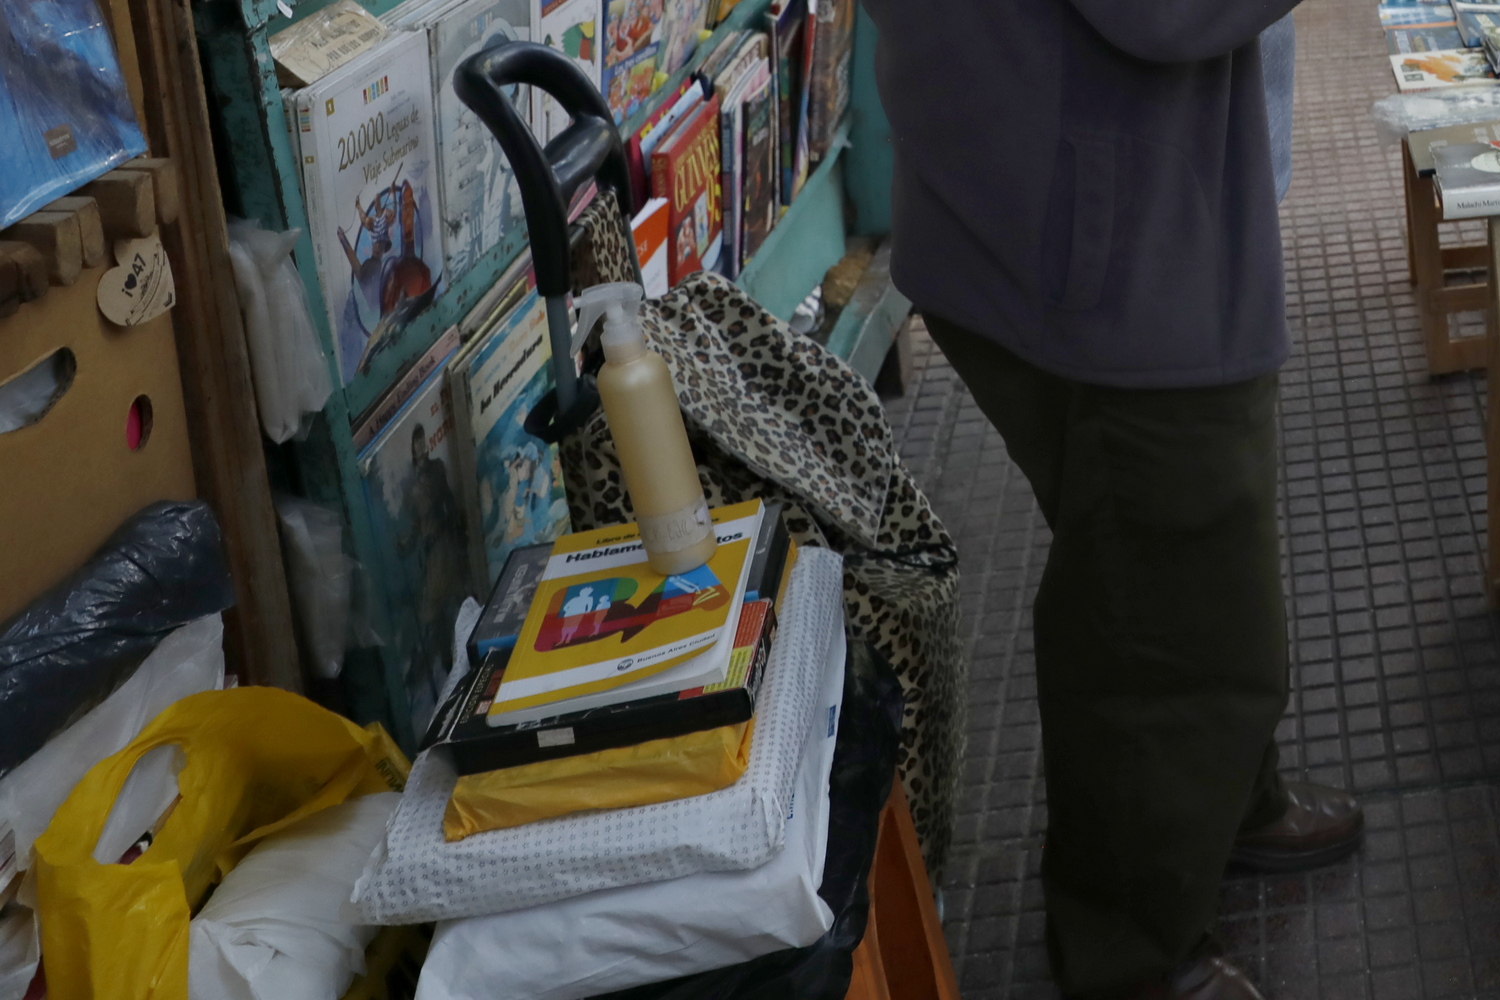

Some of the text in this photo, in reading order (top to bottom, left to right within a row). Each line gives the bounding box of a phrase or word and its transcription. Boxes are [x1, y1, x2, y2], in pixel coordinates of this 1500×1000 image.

[337, 111, 384, 173] 20.000
[132, 252, 147, 277] 47
[596, 534, 622, 546] Libro
[565, 543, 644, 565] Hablamo
[636, 632, 717, 665] Buenos Aires Ciudad
